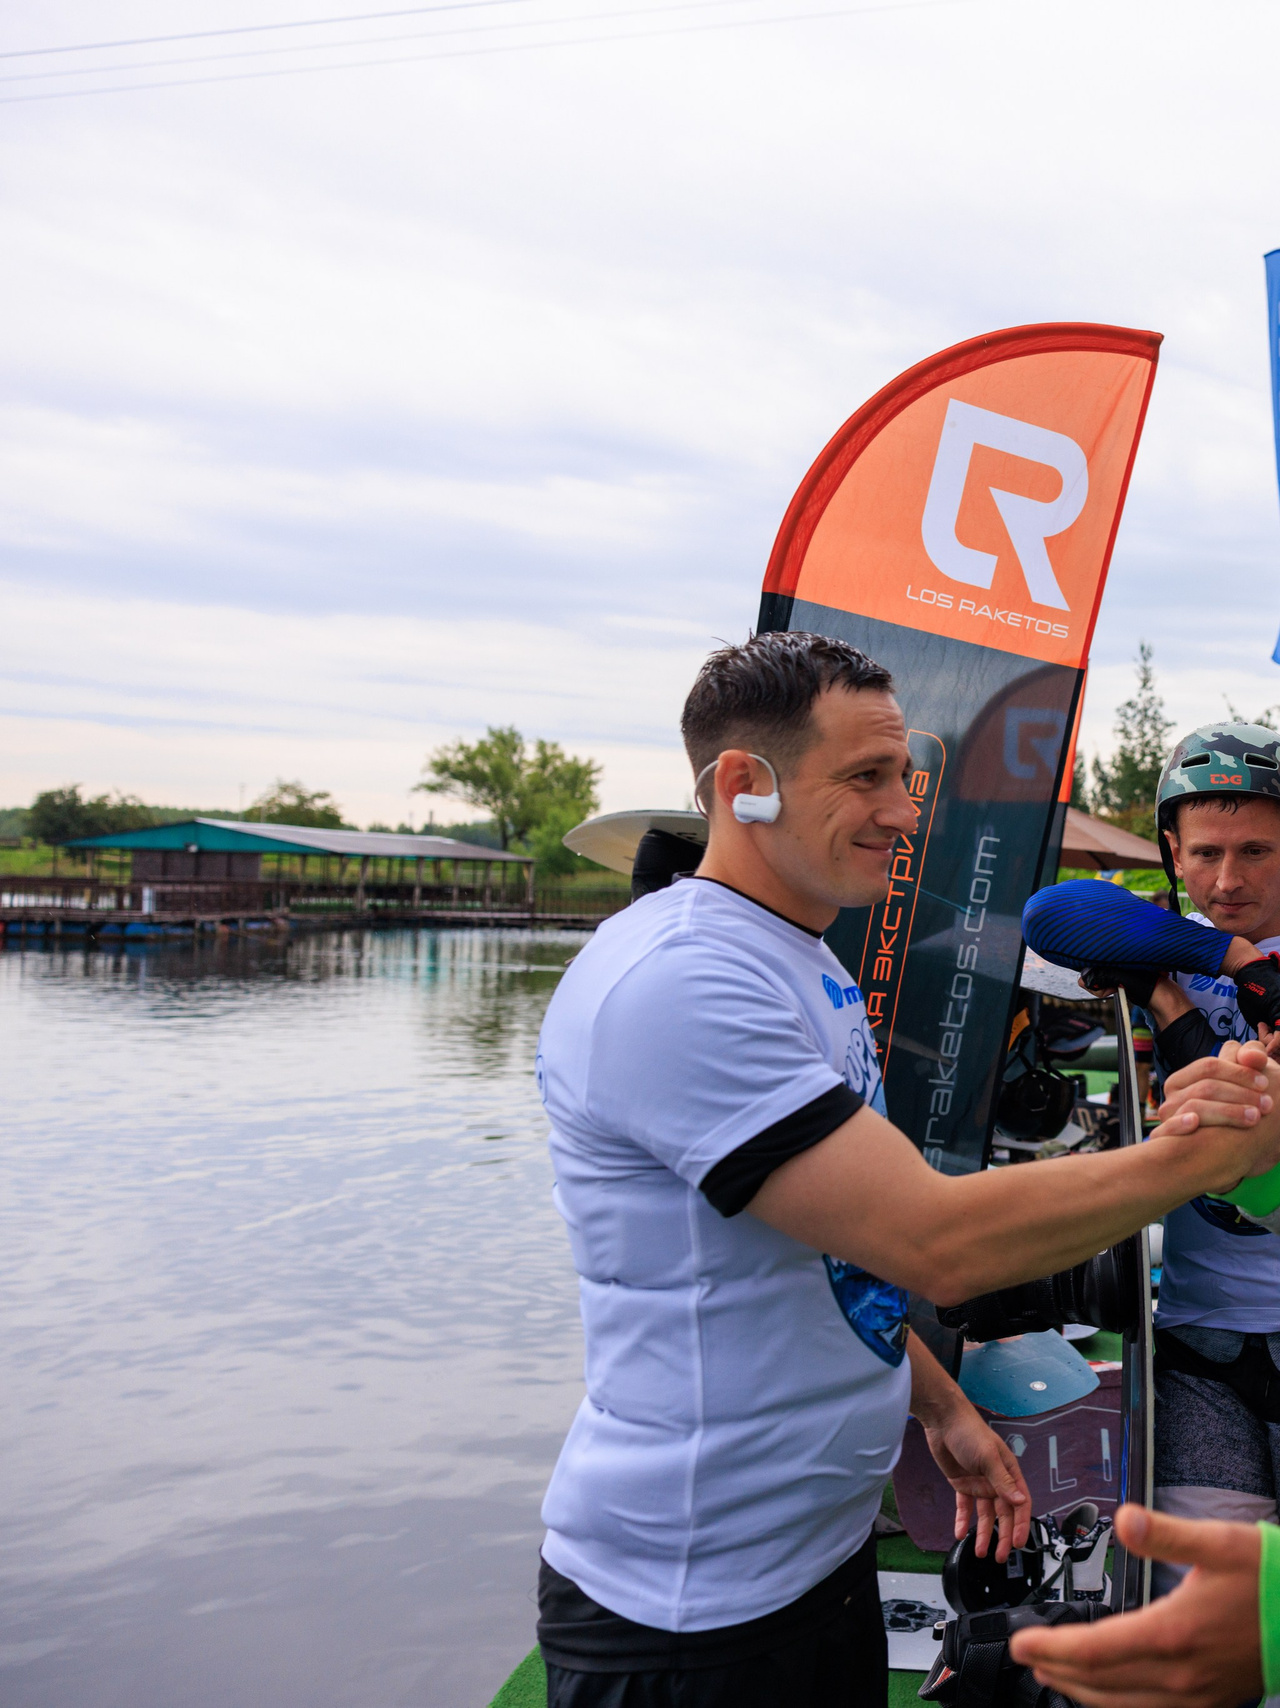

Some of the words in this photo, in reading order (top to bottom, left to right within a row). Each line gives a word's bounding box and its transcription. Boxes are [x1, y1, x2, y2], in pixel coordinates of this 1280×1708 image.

[906, 584, 954, 610] LOS
[958, 598, 1069, 639] RAKETOS
[1209, 773, 1243, 785] TSG
